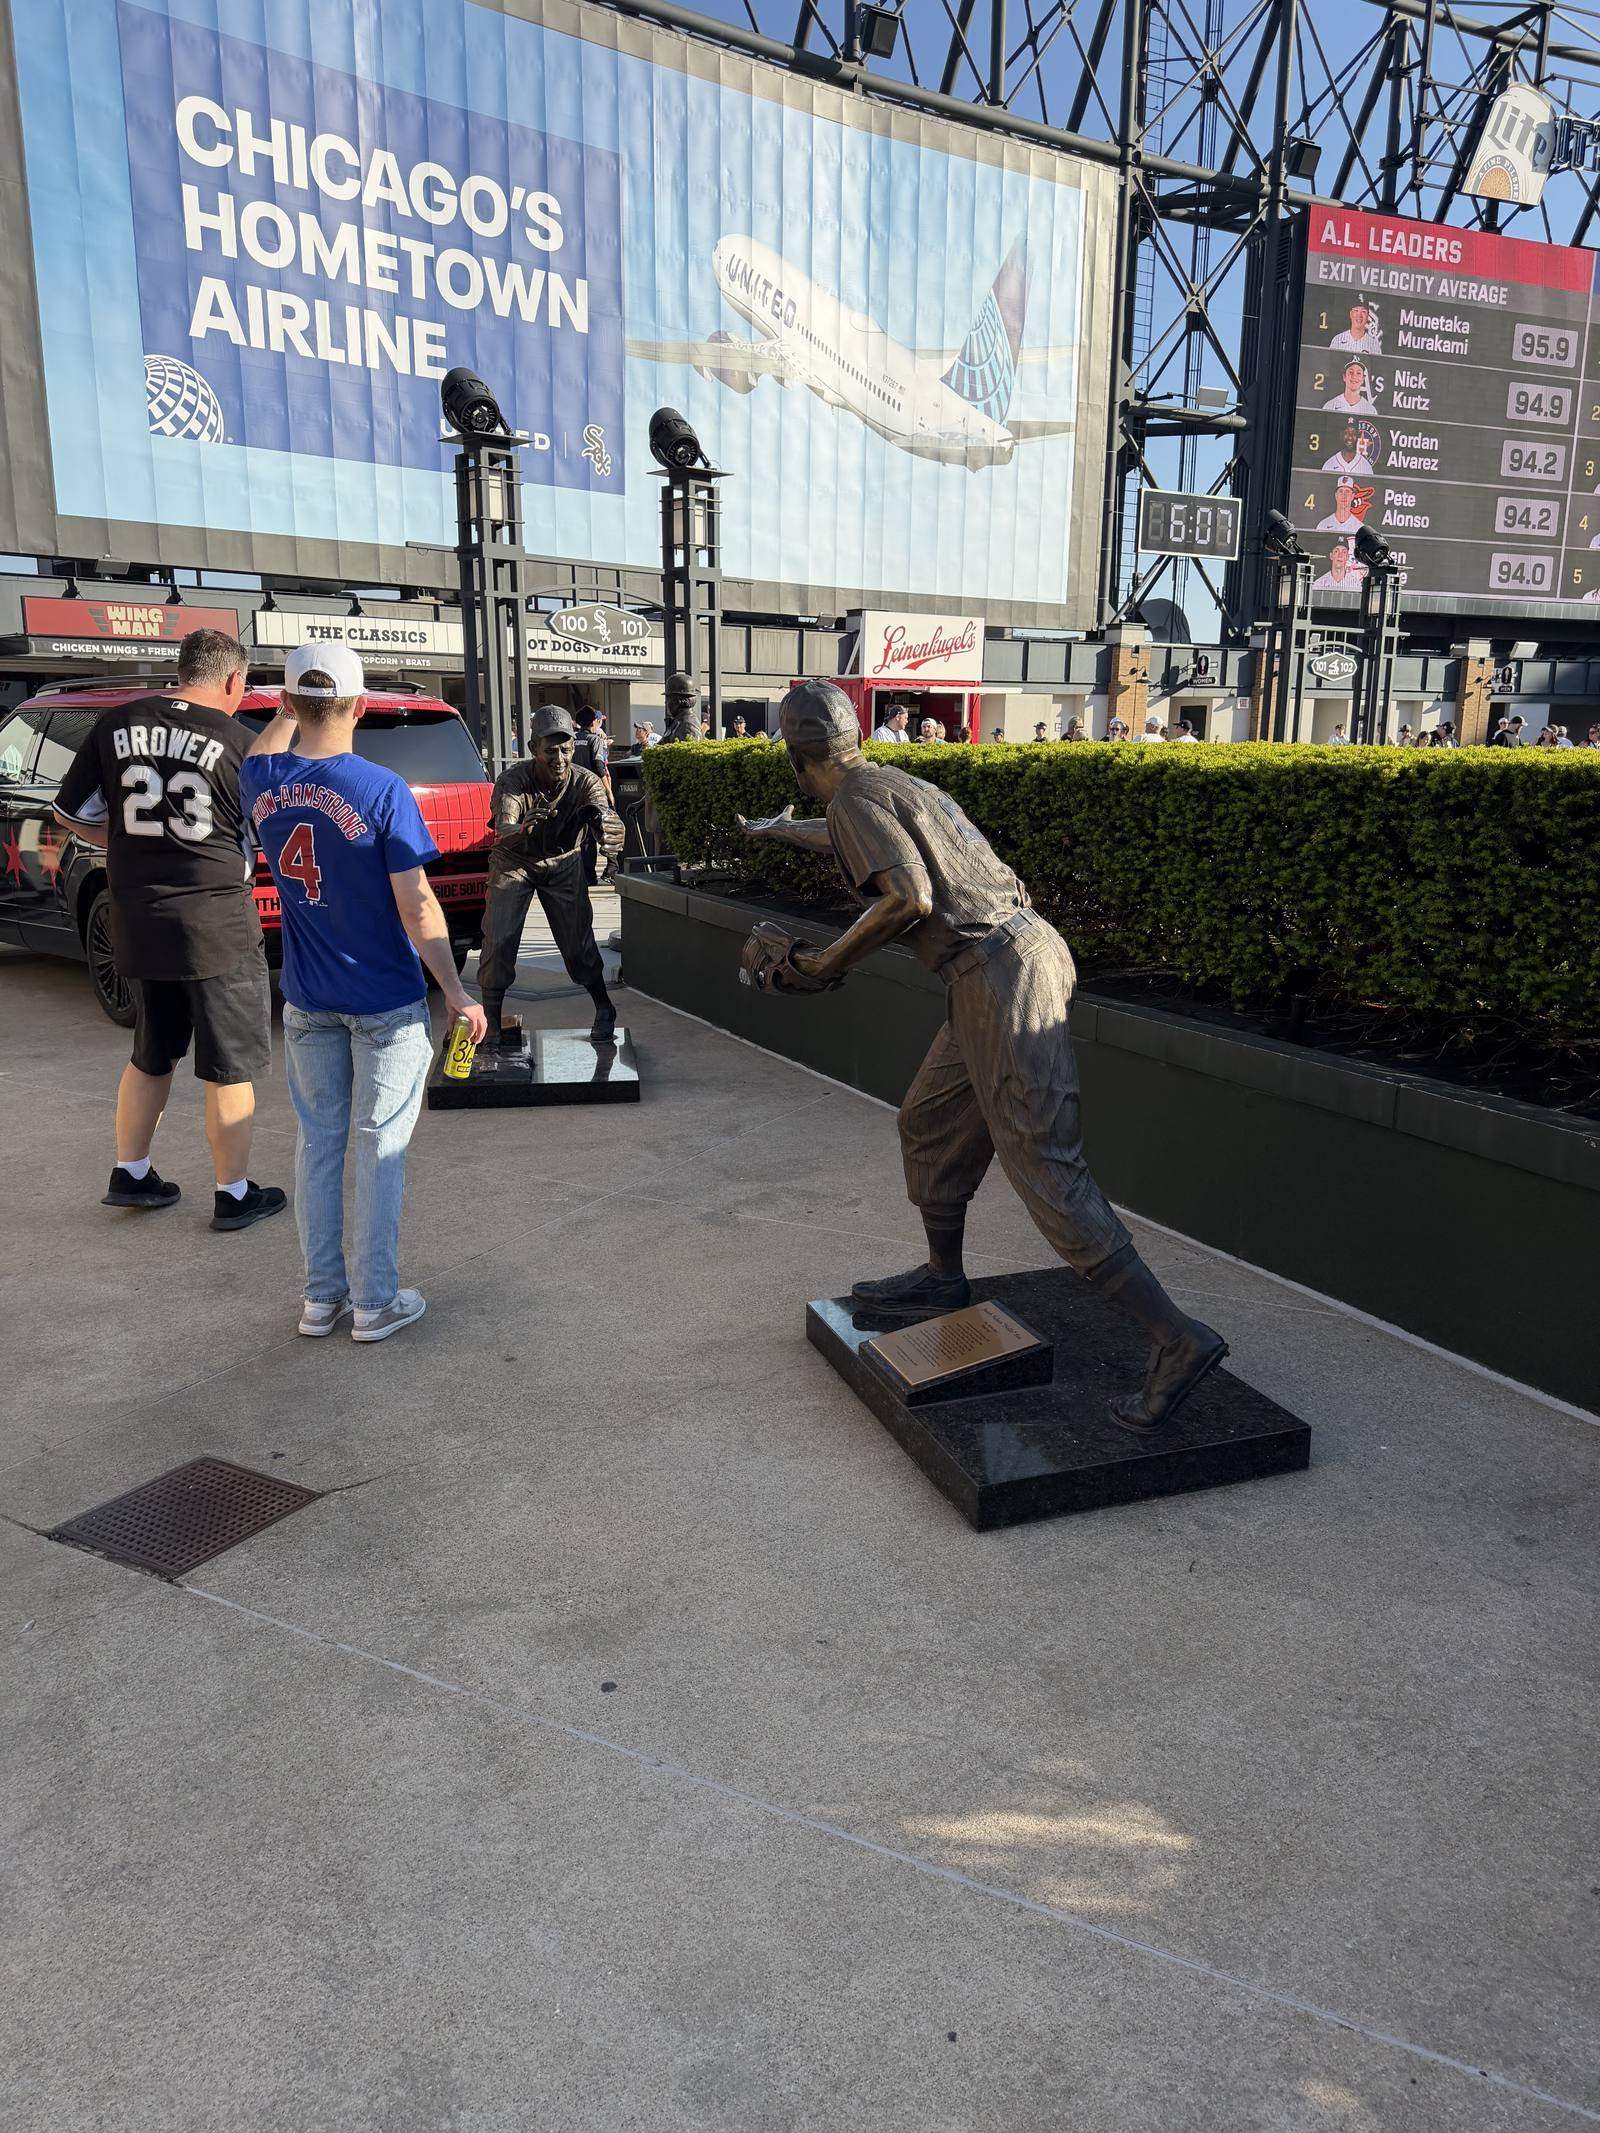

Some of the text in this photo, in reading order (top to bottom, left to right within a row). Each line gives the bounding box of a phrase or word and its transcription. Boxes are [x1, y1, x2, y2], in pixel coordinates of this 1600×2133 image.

[175, 95, 565, 253] CHICAGO'S
[1320, 220, 1463, 264] A.L. LEADERS
[181, 183, 589, 334] HOMETOWN
[727, 253, 797, 329] UNITED
[1318, 260, 1509, 305] EXIT VELOCITY AVERAGE
[189, 275, 448, 380] AIRLINE
[1318, 311, 1329, 329] 1
[1399, 308, 1471, 335] Munetaka
[1398, 331, 1469, 356] Murakami
[1520, 331, 1570, 361] 95.9
[1313, 373, 1325, 391] 2
[1394, 369, 1428, 390] Nick
[1392, 390, 1431, 411] Kurtz
[1514, 390, 1564, 420] 94.9
[1308, 434, 1320, 451] 3
[1389, 429, 1439, 451] Yordan
[1386, 450, 1439, 472] Alvarez
[1508, 448, 1558, 475] 94.2
[1585, 461, 1594, 476] 3
[1304, 493, 1316, 510] 4
[1383, 488, 1416, 508] Pete
[1169, 503, 1233, 545] 6:07
[1381, 509, 1431, 529] Alonso
[1503, 504, 1552, 531] 94.2
[1579, 514, 1589, 530] 4
[1497, 560, 1547, 585] 94.0
[1572, 568, 1583, 584] 5
[105, 604, 164, 623] WING
[112, 620, 160, 637] MAN
[306, 625, 428, 644] THE CLASSICS
[560, 614, 588, 632] 100
[621, 619, 644, 637] 101
[52, 642, 181, 657] CHICKEN WINGS FRENC
[528, 638, 648, 657] OT DOGS BRATS
[872, 619, 977, 675] Leinenkugel's
[358, 656, 432, 667] POPCORN BRATS
[539, 664, 576, 673] PRETZELS
[582, 667, 608, 675] POLISH
[609, 668, 641, 676] SAUSAGE
[1315, 661, 1353, 673] 101 102
[113, 725, 225, 772] BROWER
[619, 784, 639, 793] TRASH
[120, 764, 213, 842] 23
[252, 783, 368, 841] ROW-ARMSTRONG
[278, 822, 322, 901] 4
[432, 883, 458, 898] SIDE
